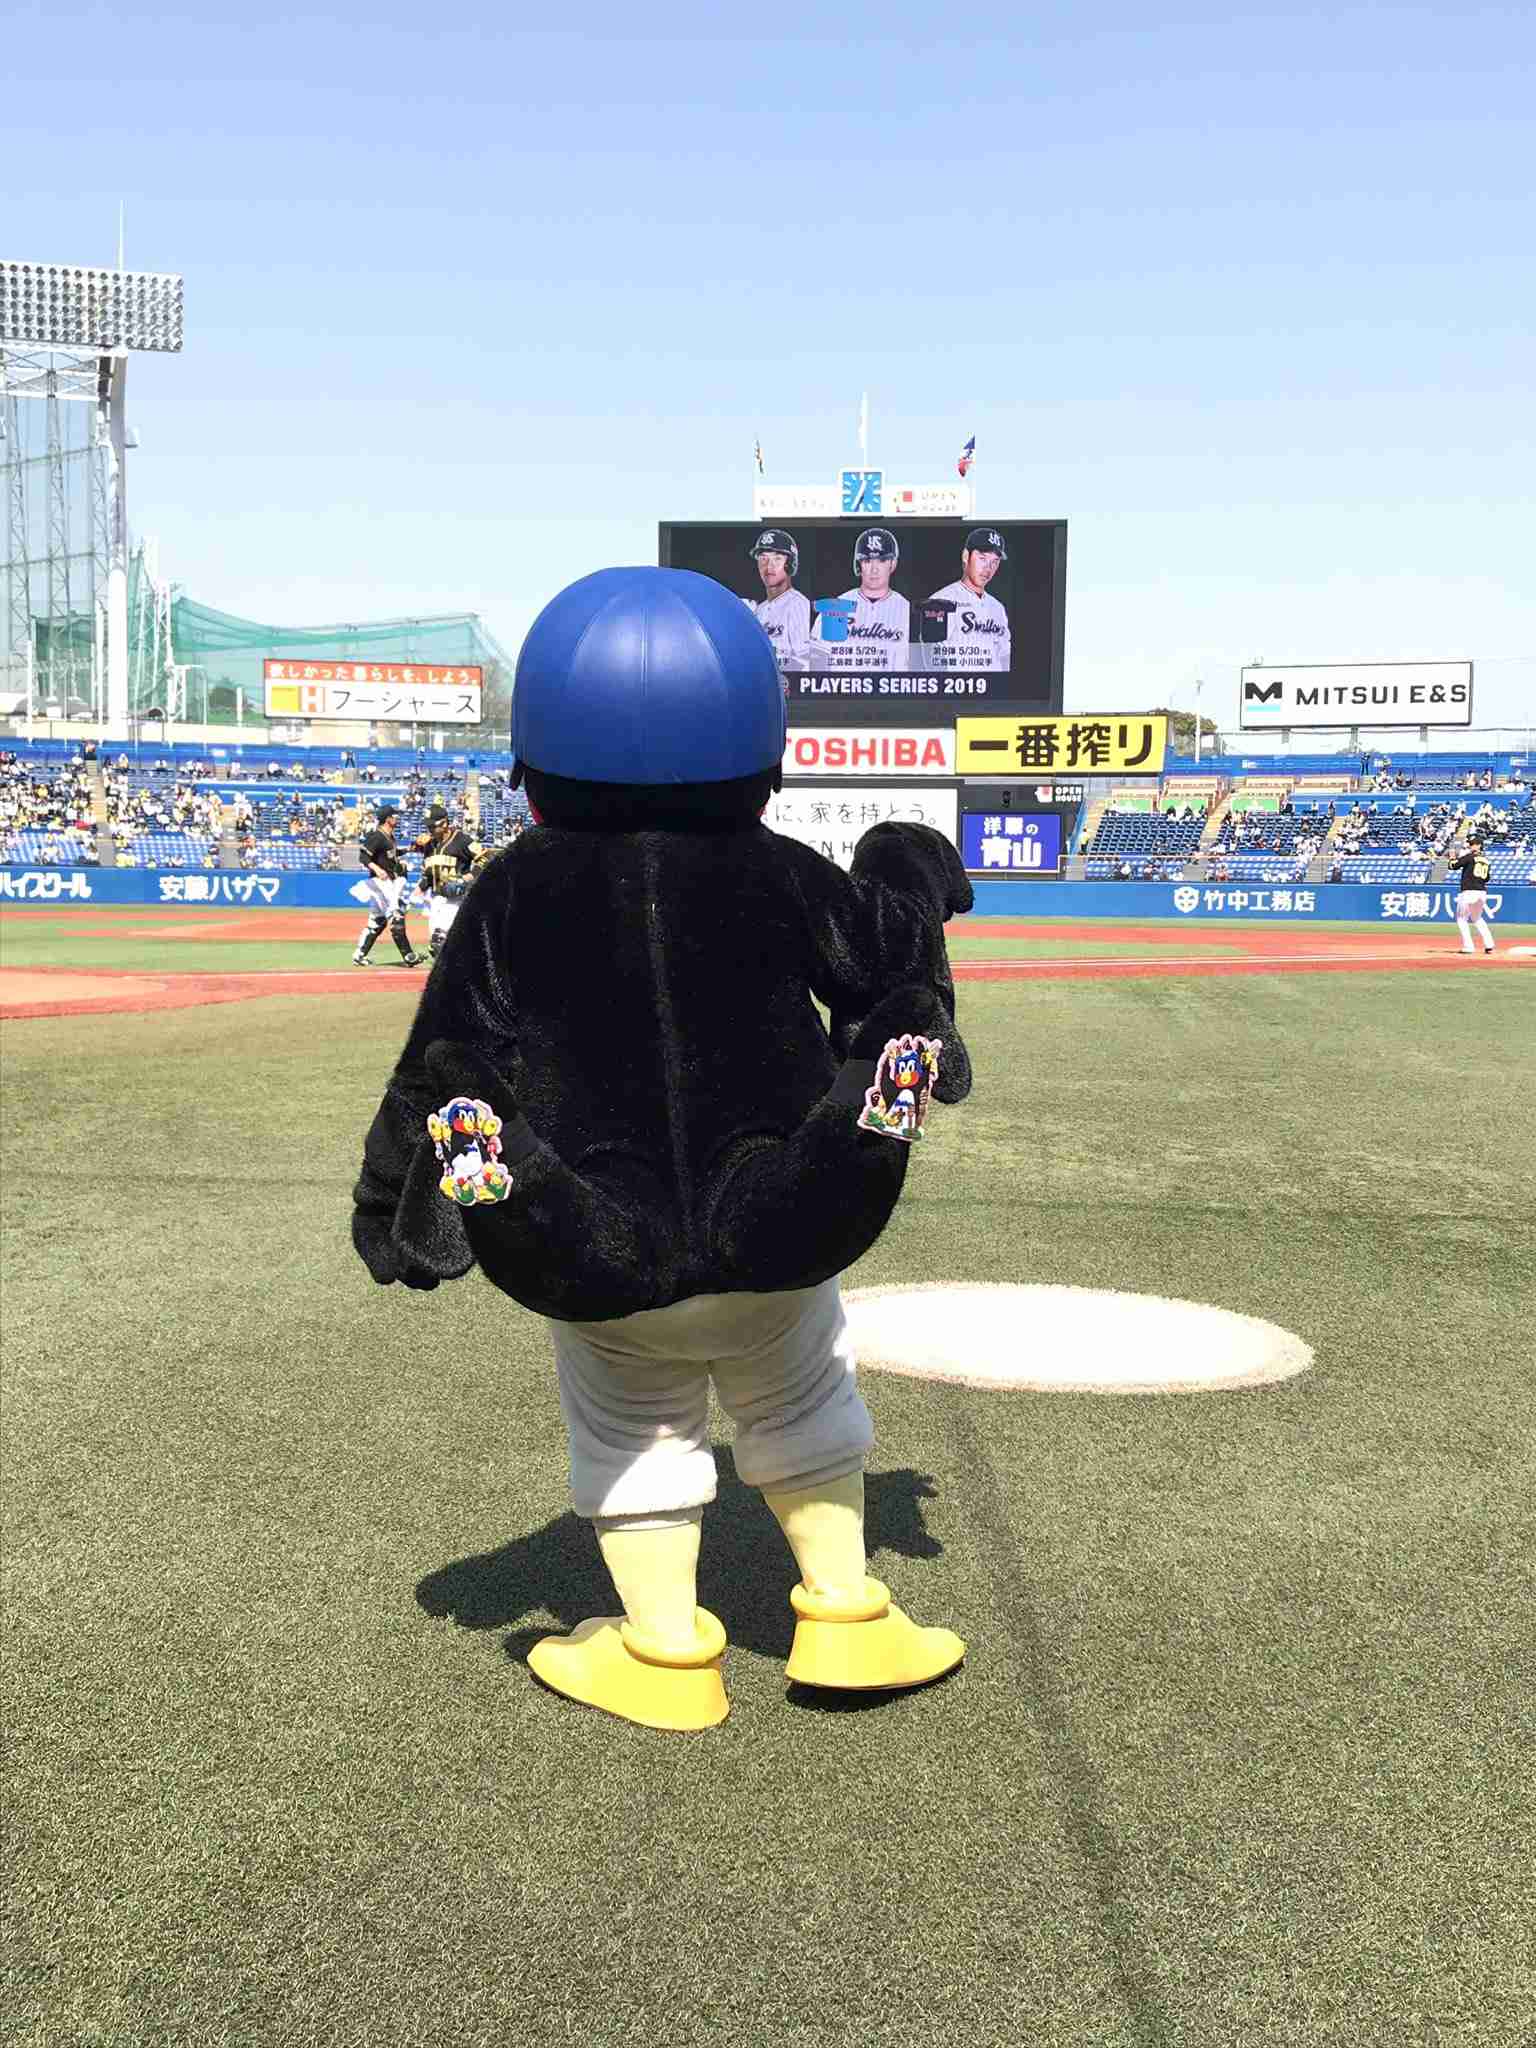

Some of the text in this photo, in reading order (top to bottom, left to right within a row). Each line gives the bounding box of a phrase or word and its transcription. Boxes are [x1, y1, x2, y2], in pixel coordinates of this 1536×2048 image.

[800, 677, 987, 695] PLAYERS SERIES 2019
[1296, 684, 1467, 705] MITSUI E&S
[332, 690, 476, 714] フーシャース
[787, 738, 946, 767] OSHIBA
[969, 723, 1152, 767] 一番搾り
[1055, 787, 1082, 795] OPEN
[980, 836, 1042, 867] 青山
[159, 875, 280, 903] 安藤ハザマ
[1203, 891, 1315, 912] 竹中工務店
[1380, 892, 1502, 919] 安藤ハマ
